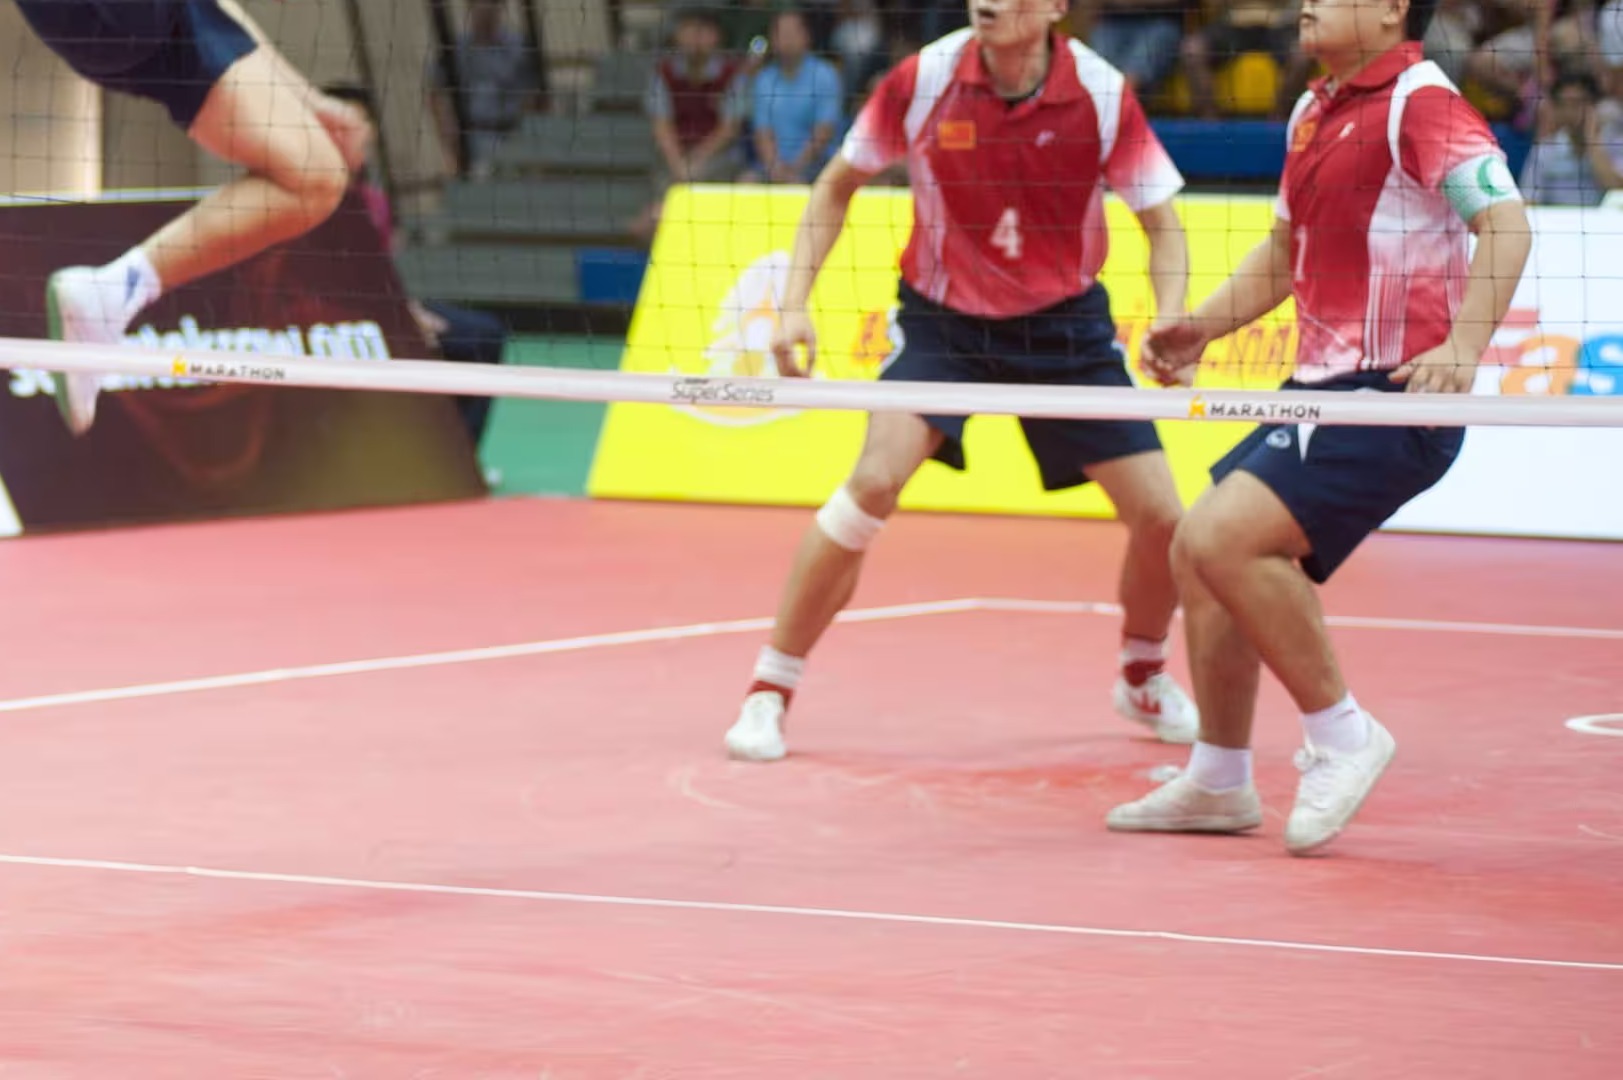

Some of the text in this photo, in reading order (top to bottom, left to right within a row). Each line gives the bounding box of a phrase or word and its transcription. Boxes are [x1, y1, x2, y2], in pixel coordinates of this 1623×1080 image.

[990, 207, 1022, 260] 4
[190, 365, 285, 380] MARATHON
[1210, 402, 1321, 419] MARATHON
